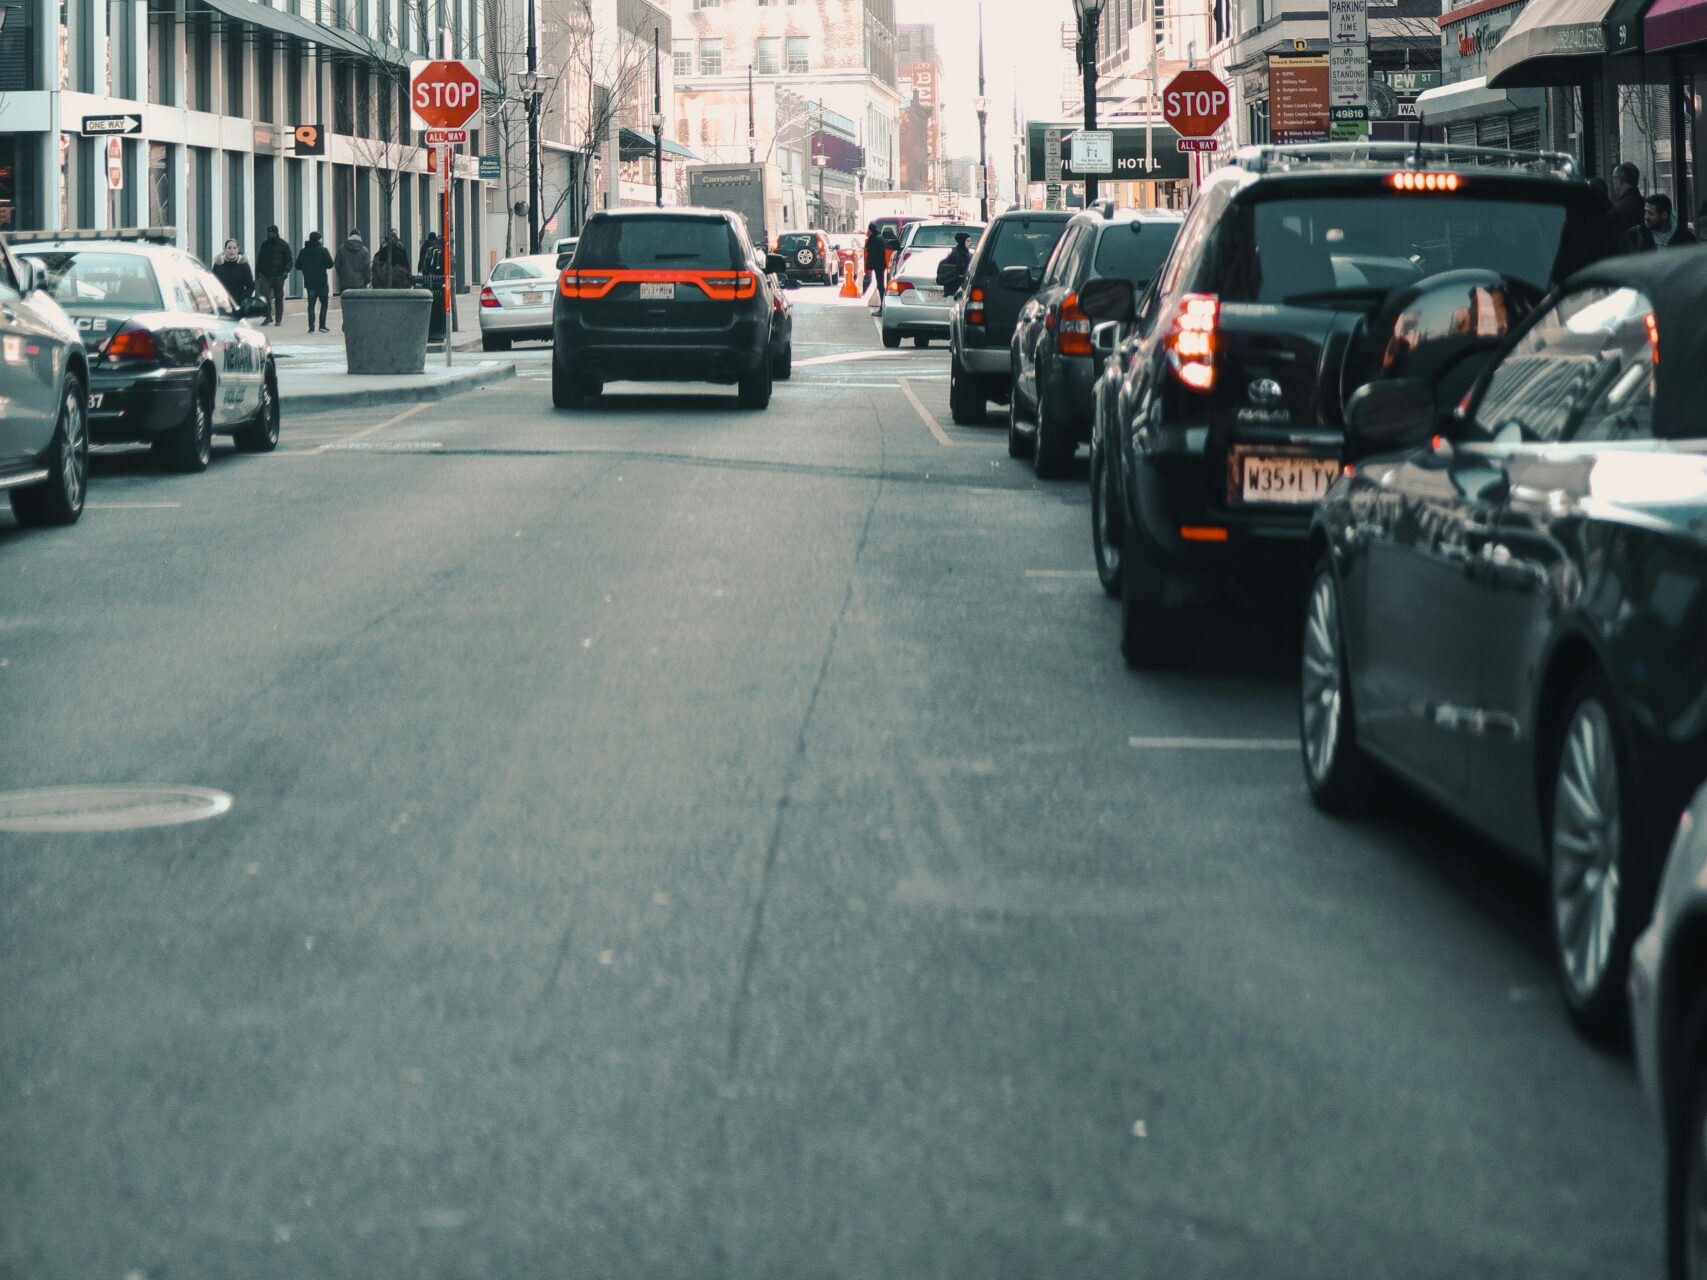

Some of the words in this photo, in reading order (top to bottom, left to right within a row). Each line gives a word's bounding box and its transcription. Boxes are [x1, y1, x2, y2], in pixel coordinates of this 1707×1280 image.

[1332, 1, 1364, 13] PARKING
[1341, 14, 1355, 22] ANY
[1339, 23, 1357, 31] TIME
[1343, 48, 1353, 57] NO
[1332, 57, 1365, 65] STOPPING
[1332, 70, 1365, 78] STANDING
[1421, 73, 1432, 82] ST
[416, 82, 476, 108] STOP
[1167, 90, 1226, 117] STOP
[1335, 109, 1364, 119] 49816
[1400, 104, 1416, 114] WA
[89, 121, 105, 130] ONE
[108, 120, 124, 129] WAY
[295, 126, 317, 147] Q
[429, 133, 444, 141] ALL
[448, 132, 463, 140] WAY
[1180, 141, 1196, 150] ALL
[1199, 140, 1214, 149] WAY
[1117, 158, 1162, 169] HOTL
